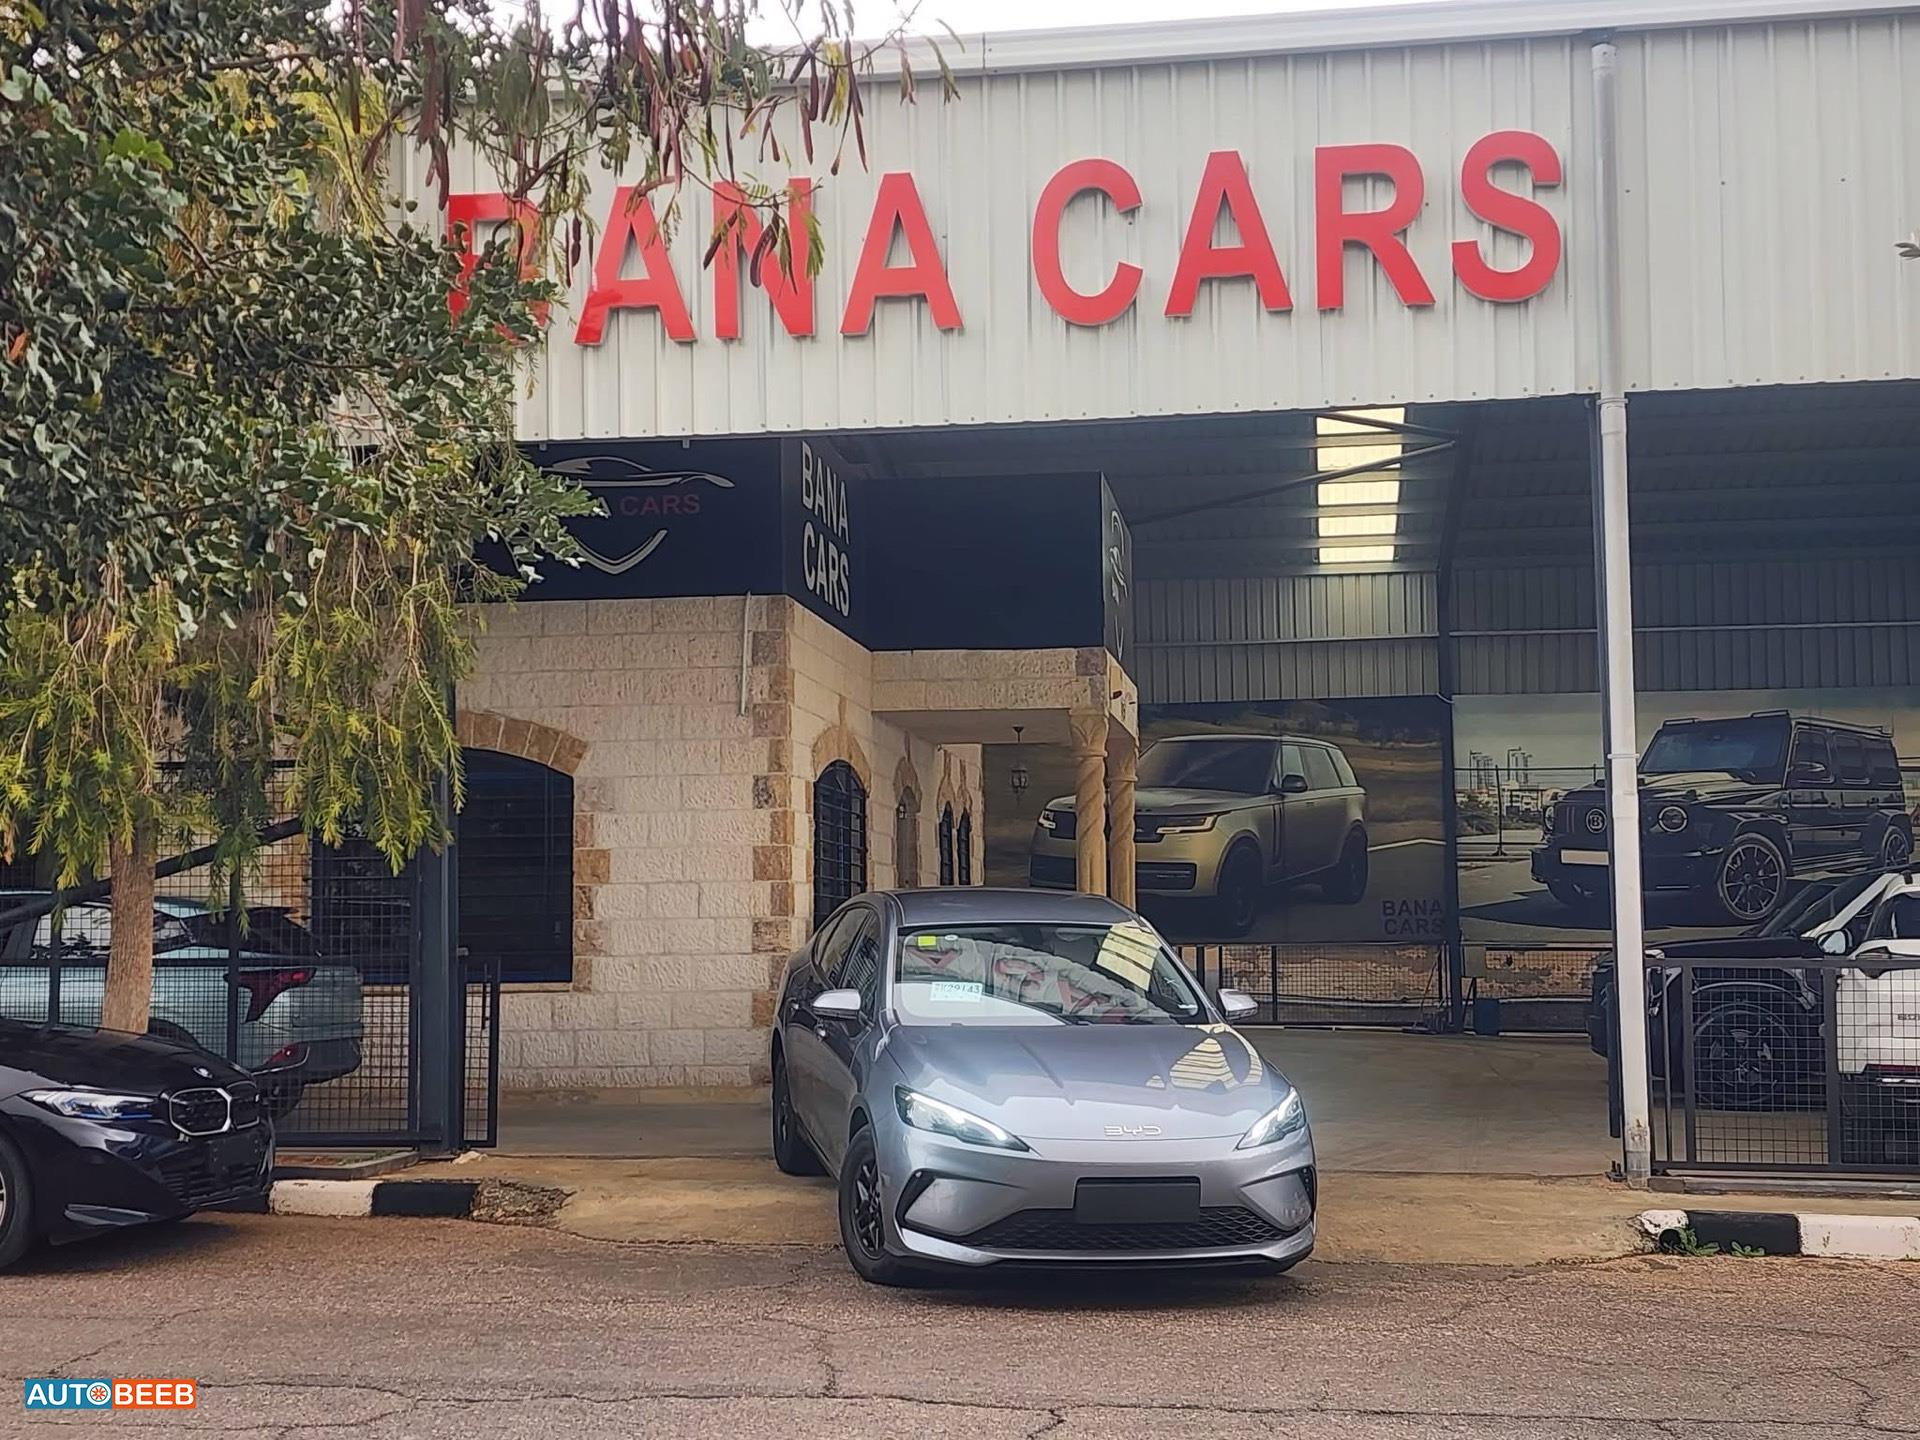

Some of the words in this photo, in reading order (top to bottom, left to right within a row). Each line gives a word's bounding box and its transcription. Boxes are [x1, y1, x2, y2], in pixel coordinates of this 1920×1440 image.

[1032, 130, 1562, 326] CARS
[802, 440, 849, 544] BANA
[619, 494, 700, 516] CARS
[803, 521, 849, 617] CARS
[1382, 899, 1442, 916] BANA
[1384, 918, 1446, 936] CARS
[1104, 1125, 1162, 1137] BYD
